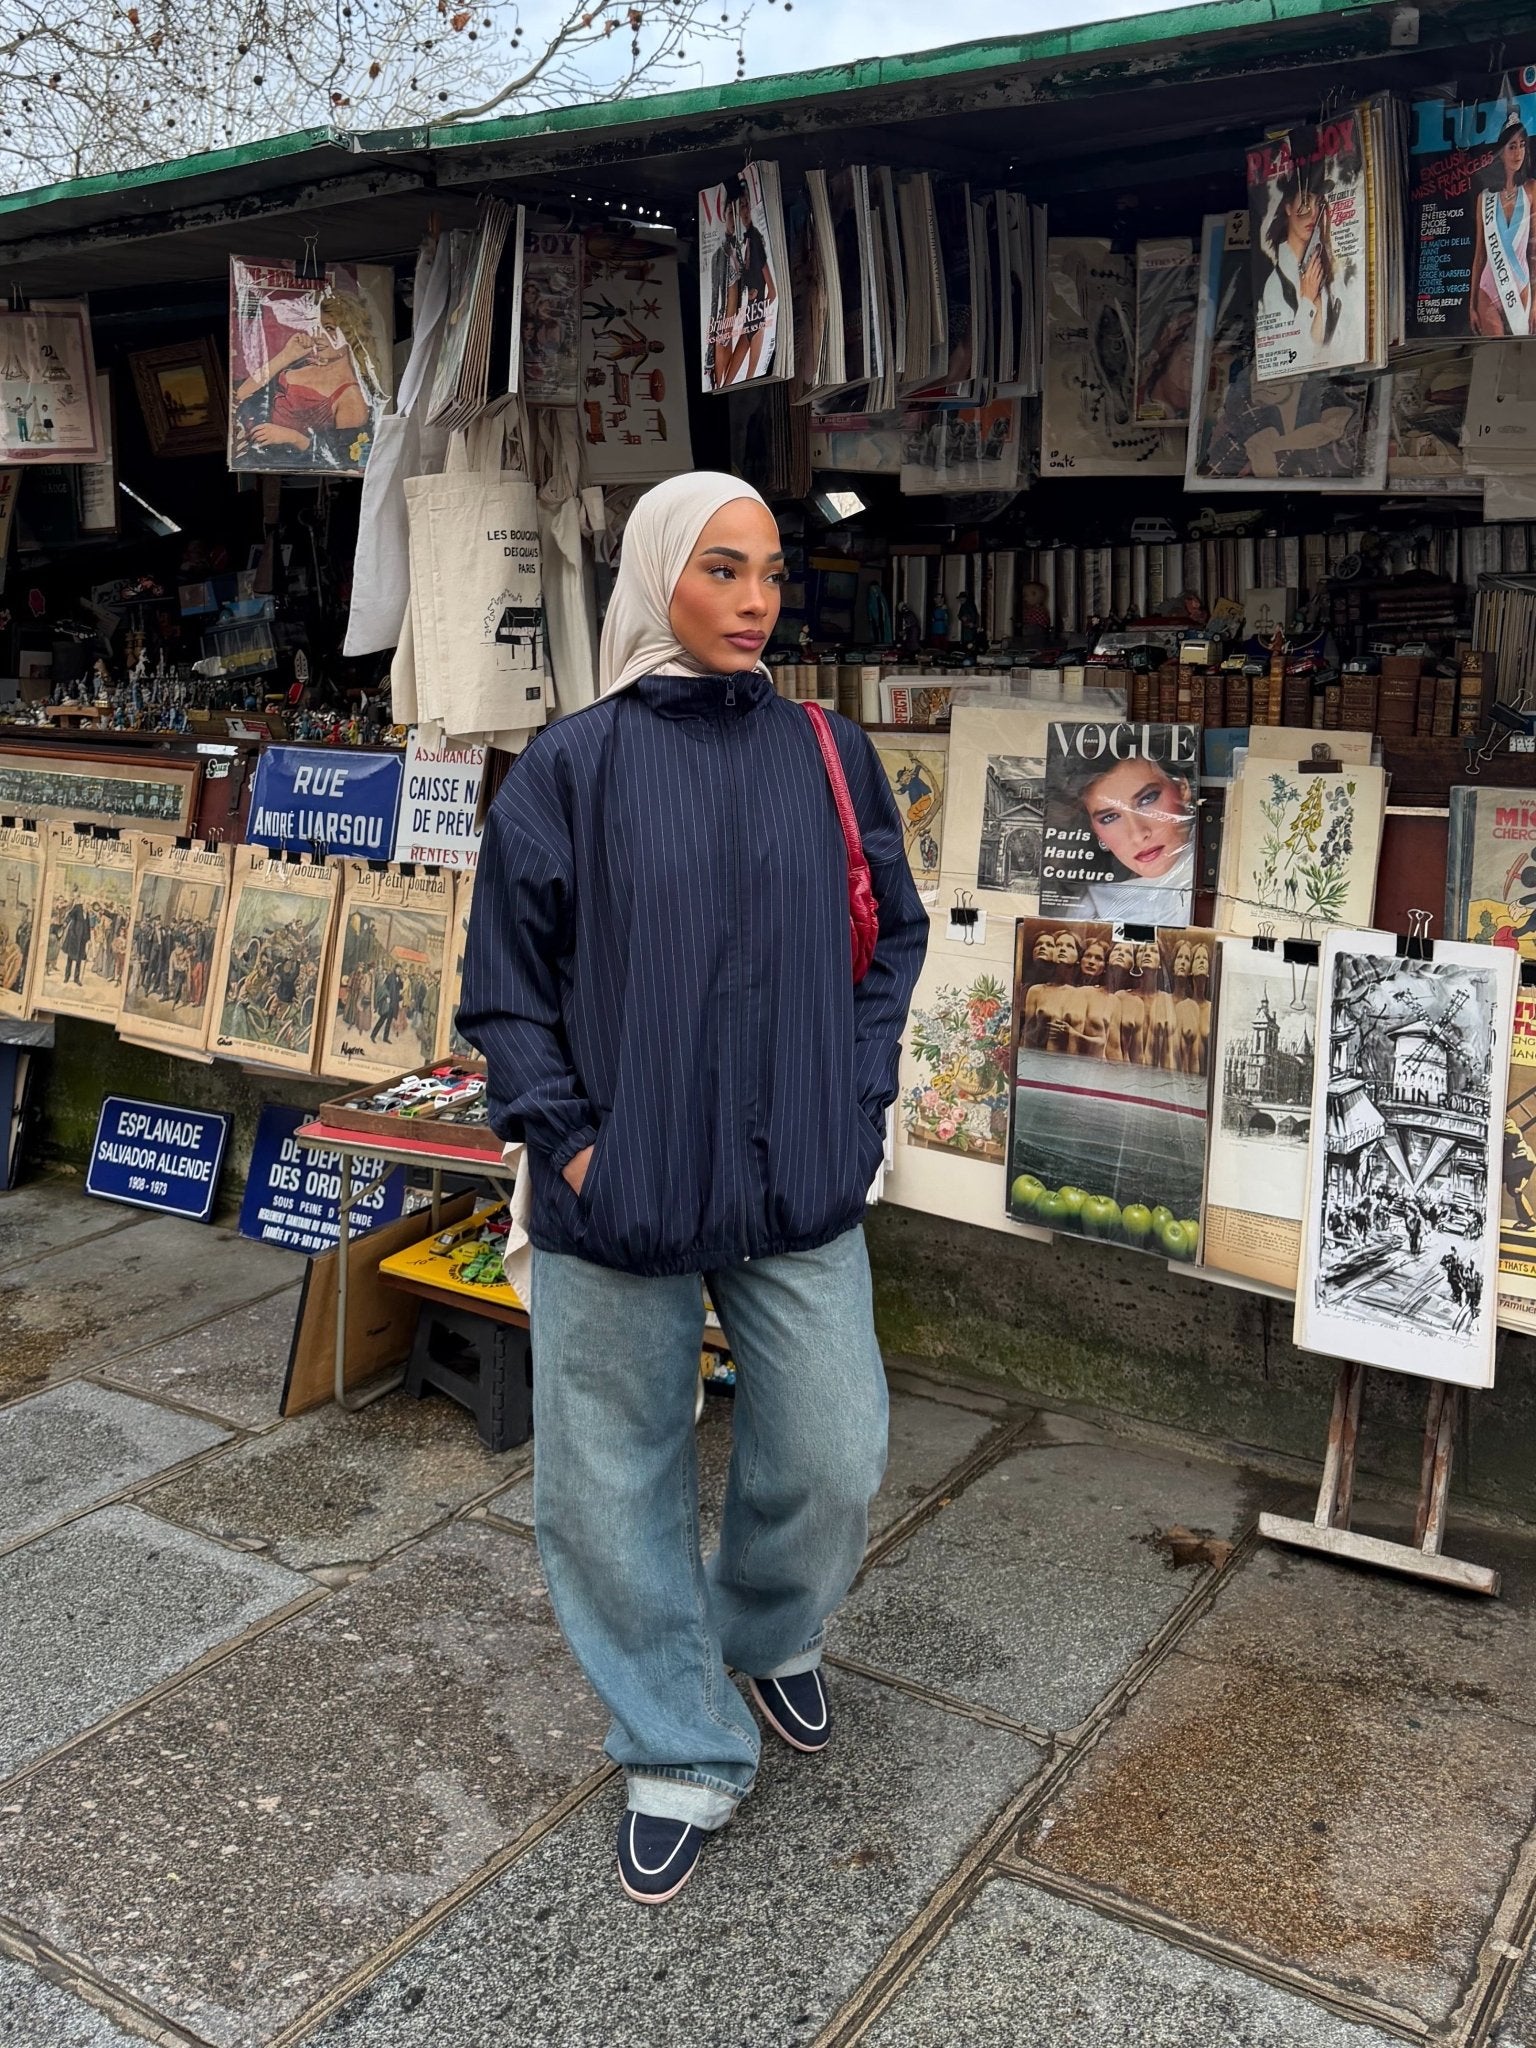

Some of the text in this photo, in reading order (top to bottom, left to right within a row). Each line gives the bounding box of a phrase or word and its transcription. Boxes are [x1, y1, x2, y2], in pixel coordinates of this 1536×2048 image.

[1247, 119, 1354, 186] PLAOY
[1488, 232, 1510, 286] FRANCE
[1505, 290, 1517, 309] 85
[487, 530, 507, 541] LES
[518, 564, 536, 574] PARIS
[1054, 723, 1196, 762] VOGUE
[293, 766, 349, 797] RUE
[409, 776, 459, 803] CAISSE
[299, 809, 383, 848] LIARSOU
[413, 808, 482, 838] DE PRÉV
[1045, 828, 1091, 841] Paris
[61, 831, 73, 847] Le
[150, 841, 163, 857] Le
[410, 845, 459, 865] RENTES
[1044, 846, 1095, 860] Haute
[250, 854, 264, 871] Le
[294, 862, 332, 880] Journal
[1043, 866, 1115, 882] Couture
[357, 868, 371, 885] Le
[408, 877, 446, 894] Journal
[117, 1111, 204, 1149] ESPLANADE
[98, 1141, 212, 1182] SALVADOR ALLENDE
[269, 1163, 302, 1192] DES
[272, 1195, 294, 1210] SOUS
[299, 1201, 323, 1215] PEINE
